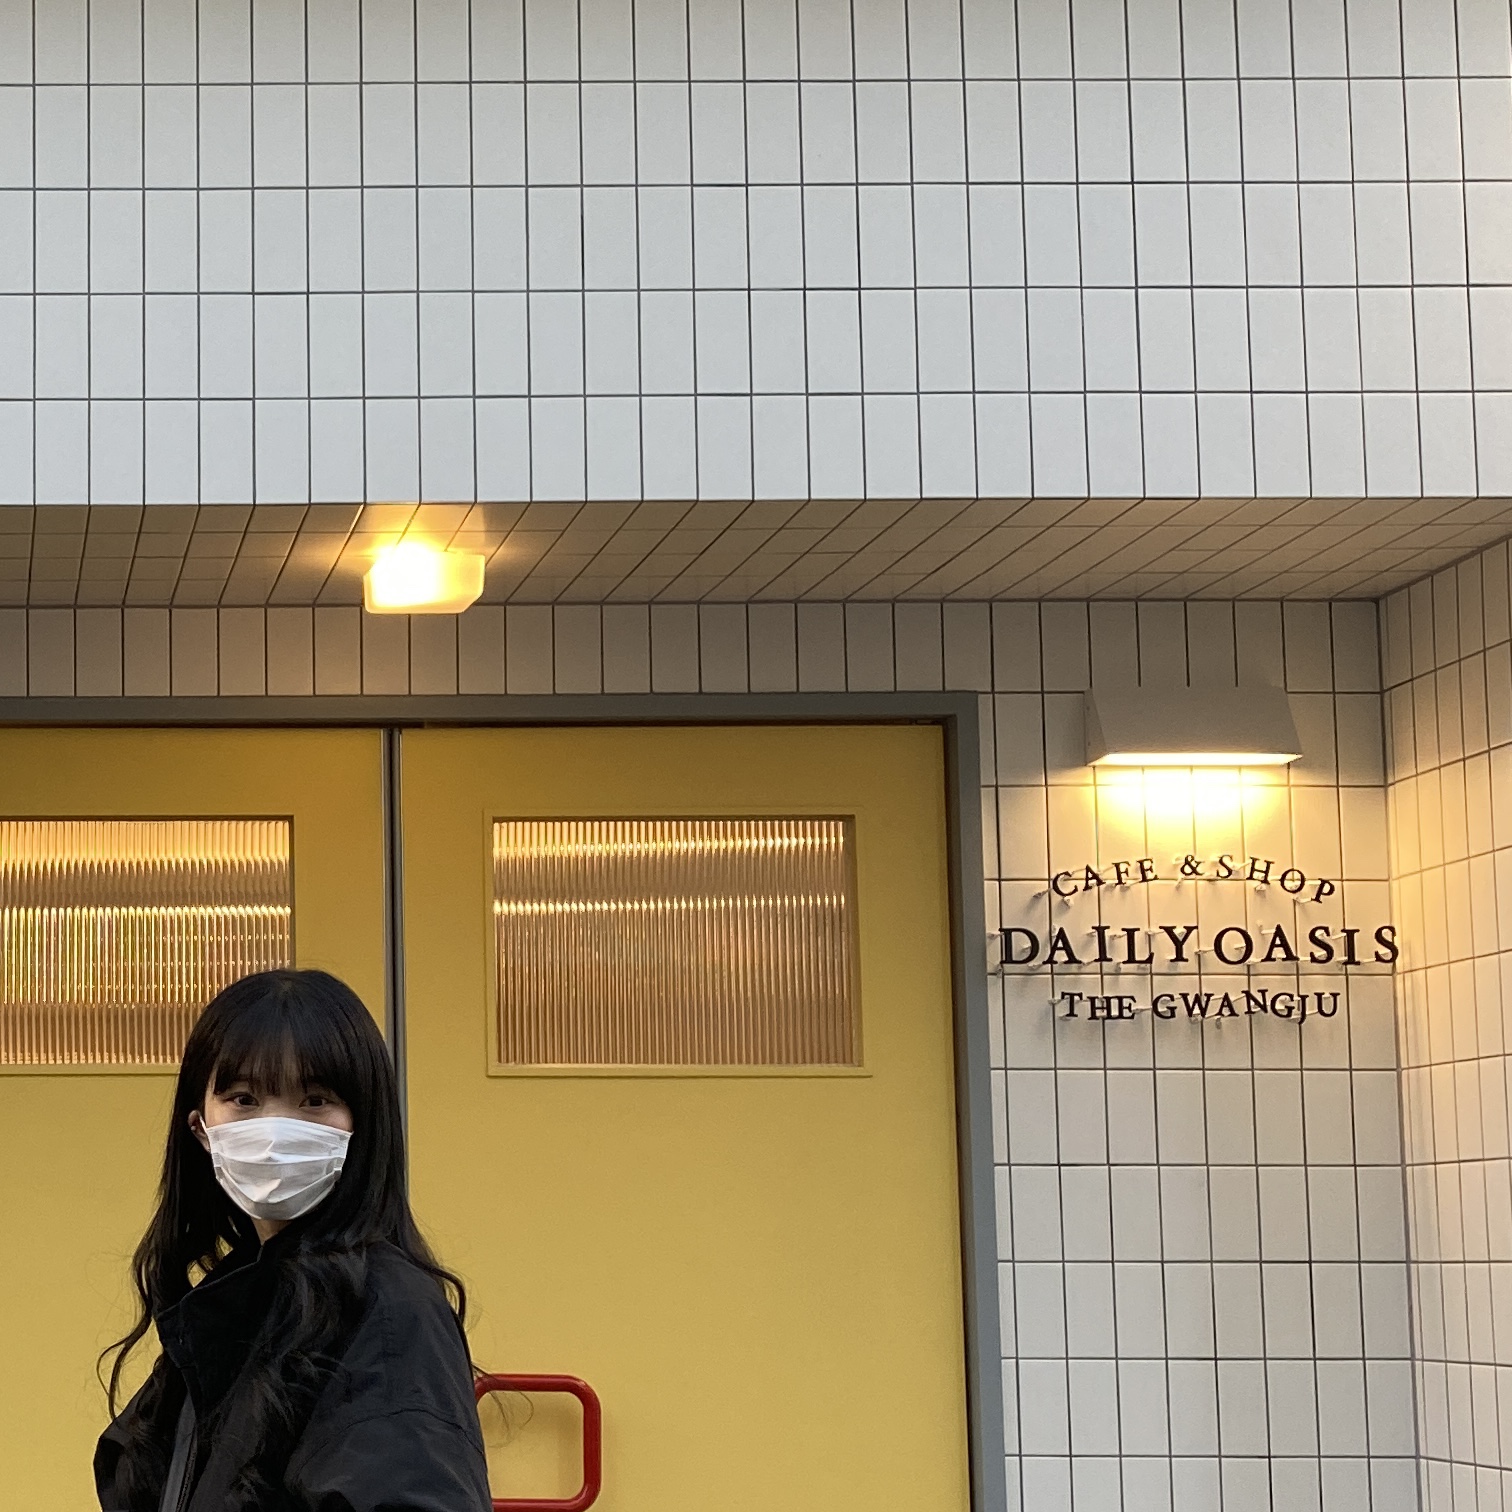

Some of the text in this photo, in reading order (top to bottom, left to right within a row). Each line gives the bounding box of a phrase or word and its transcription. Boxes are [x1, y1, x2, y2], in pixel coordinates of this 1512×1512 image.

[1051, 854, 1336, 904] CAFE & SHOP
[999, 924, 1399, 967] DAILY OASIS
[1060, 988, 1341, 1025] THE GWANGJU
